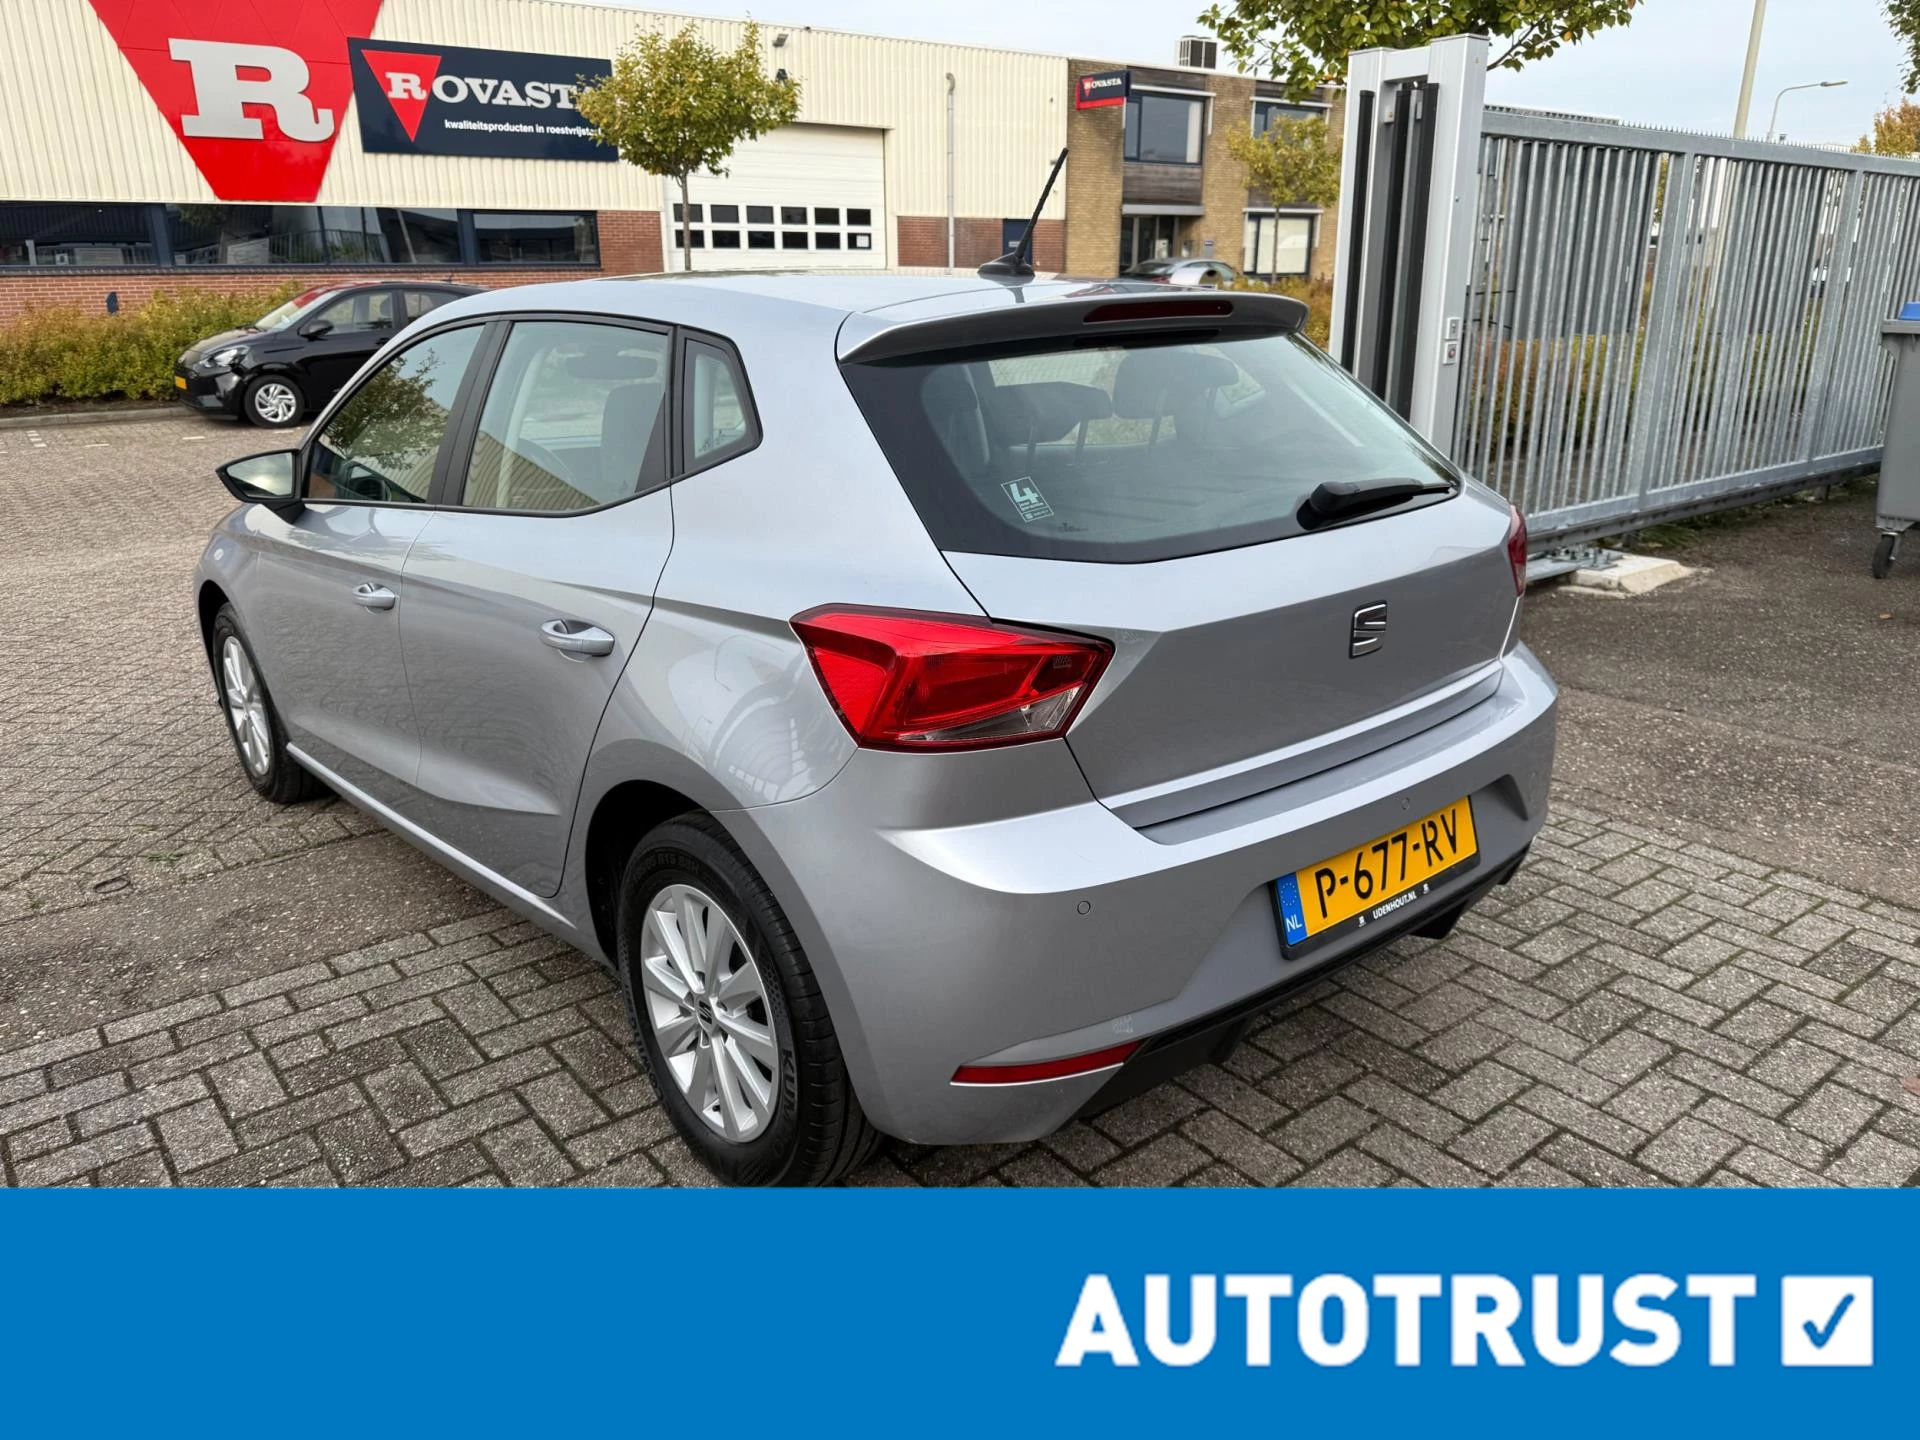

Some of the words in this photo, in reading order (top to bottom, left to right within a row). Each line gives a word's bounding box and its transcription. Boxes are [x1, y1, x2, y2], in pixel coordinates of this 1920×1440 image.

[168, 38, 335, 142] R
[385, 72, 595, 110] ROVAST
[444, 119, 534, 134] kwaliteitsproducten
[535, 124, 545, 134] in
[1315, 808, 1457, 919] P-677-RV
[1372, 891, 1417, 919] UDENHOUT.NL
[1285, 914, 1303, 933] NL
